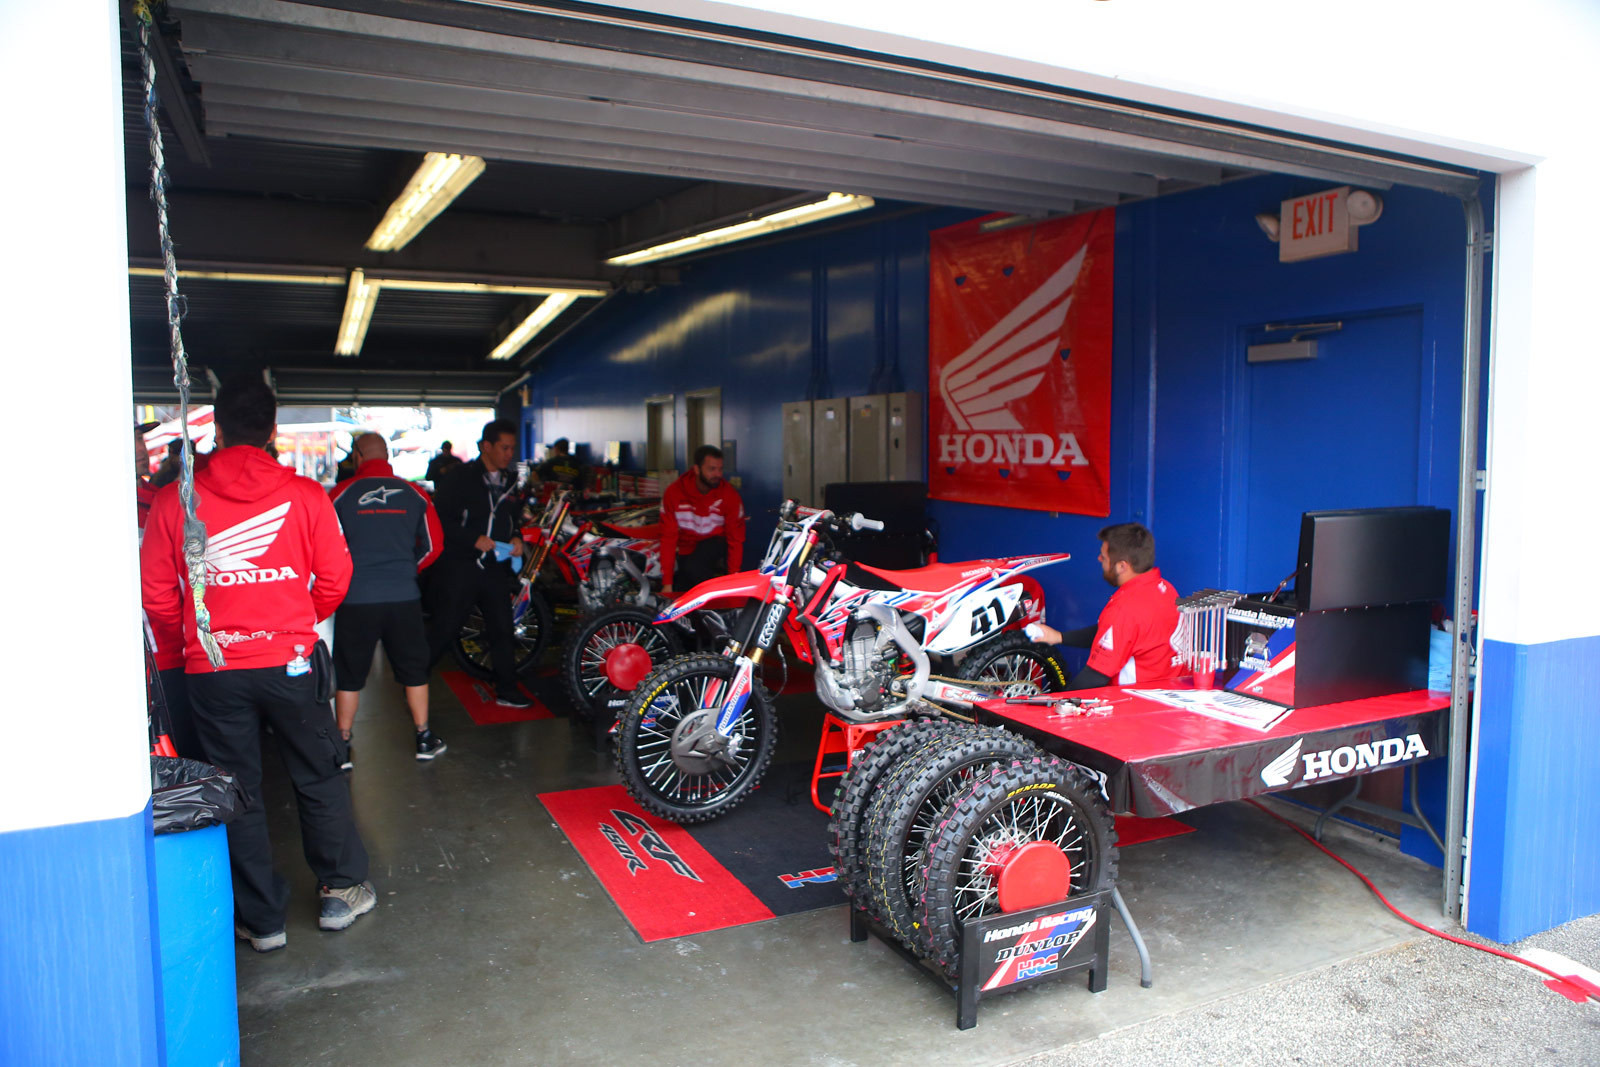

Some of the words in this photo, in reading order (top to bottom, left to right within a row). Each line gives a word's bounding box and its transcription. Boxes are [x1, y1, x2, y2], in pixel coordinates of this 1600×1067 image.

[1292, 192, 1338, 240] EXIT
[938, 433, 1089, 466] HONDA
[757, 603, 786, 647] KYB
[970, 596, 1006, 636] 41
[1258, 611, 1295, 629] Racing
[1302, 733, 1429, 780] HONDA
[1007, 783, 1056, 798] DUNLOP
[599, 823, 649, 876] 450R
[610, 809, 704, 882] CRF
[778, 866, 839, 889] HR
[983, 921, 1039, 943] Honda
[1040, 907, 1093, 929] Racing
[994, 931, 1080, 963] DUNLOP
[1017, 953, 1058, 979] HRC
